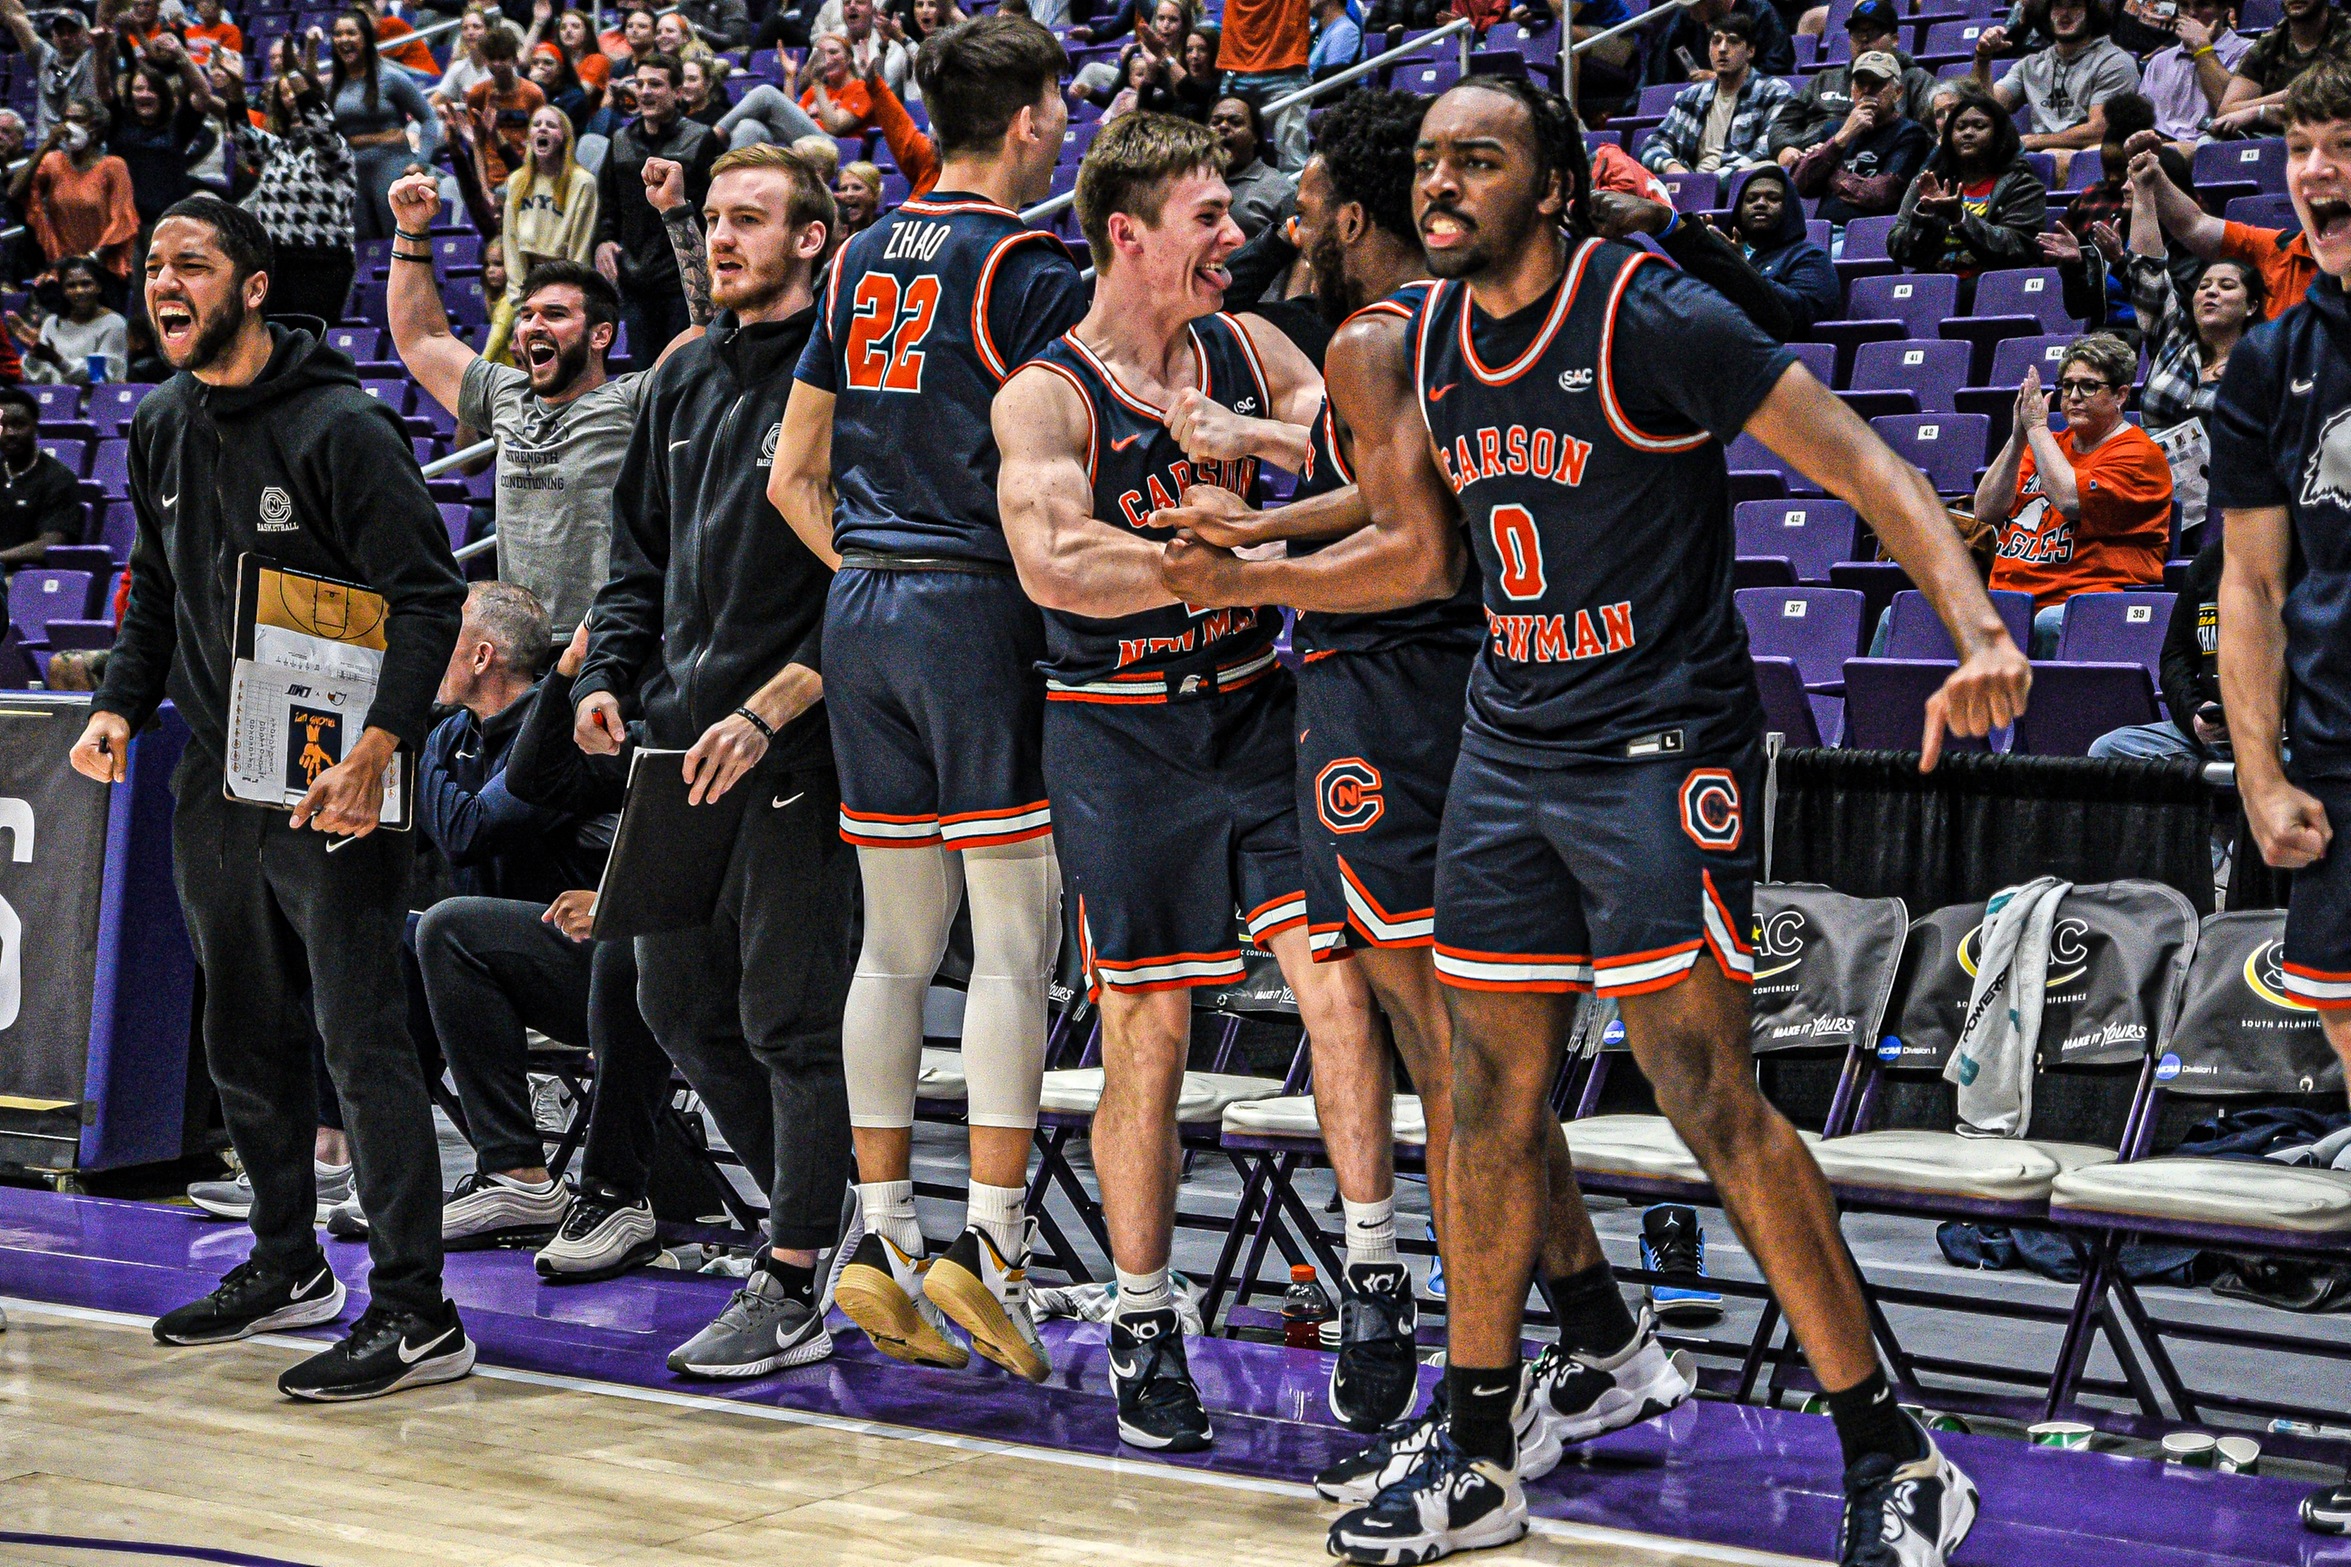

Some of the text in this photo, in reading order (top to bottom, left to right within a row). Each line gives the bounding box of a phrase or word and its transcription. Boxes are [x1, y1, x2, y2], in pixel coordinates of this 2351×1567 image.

[520, 194, 564, 218] NY
[883, 221, 950, 262] ZHAO
[845, 270, 942, 393] 22
[505, 450, 559, 464] STRENGTH
[500, 475, 565, 490] CONDITIONING
[256, 522, 300, 532] BASKETBALL
[1489, 503, 1547, 600] 0
[1790, 603, 1802, 614] 37
[2133, 608, 2146, 619] 39
[1483, 601, 1635, 663] WMAN
[1665, 736, 1675, 747] L
[1753, 984, 1800, 995] CONFERENCE
[2046, 993, 2087, 1004] NFERENCE
[1773, 1013, 1856, 1038] MAKE IT YOURS
[2241, 1019, 2274, 1029] SOUTH
[2061, 1021, 2147, 1051] MAKE IT YOURS
